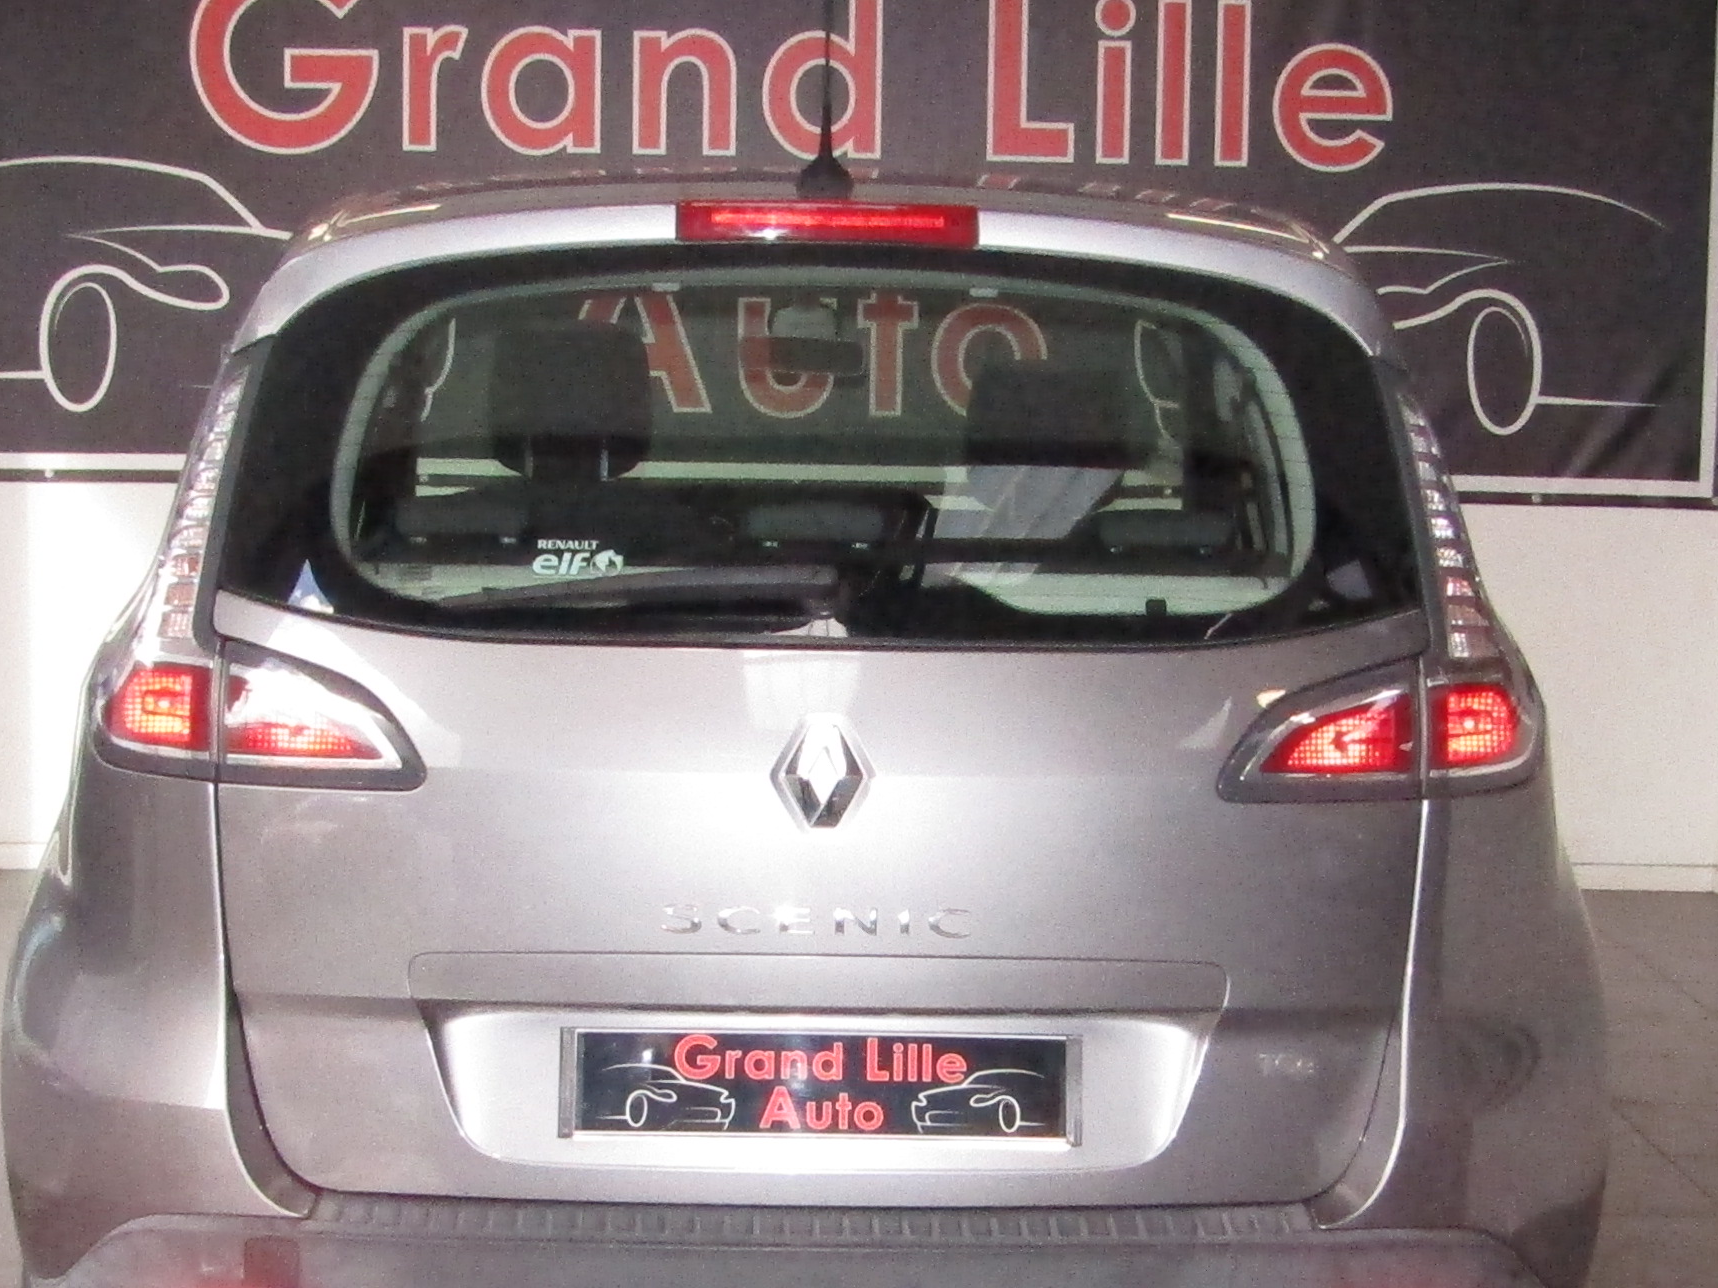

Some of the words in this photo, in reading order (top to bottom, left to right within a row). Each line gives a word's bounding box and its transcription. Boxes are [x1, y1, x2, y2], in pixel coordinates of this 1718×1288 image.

[537, 538, 600, 550] RENAULT
[532, 552, 591, 576] elf
[661, 904, 971, 939] SCENIC
[674, 1034, 844, 1080] Grand
[866, 1037, 968, 1083] Lille
[759, 1085, 884, 1130] Auto
